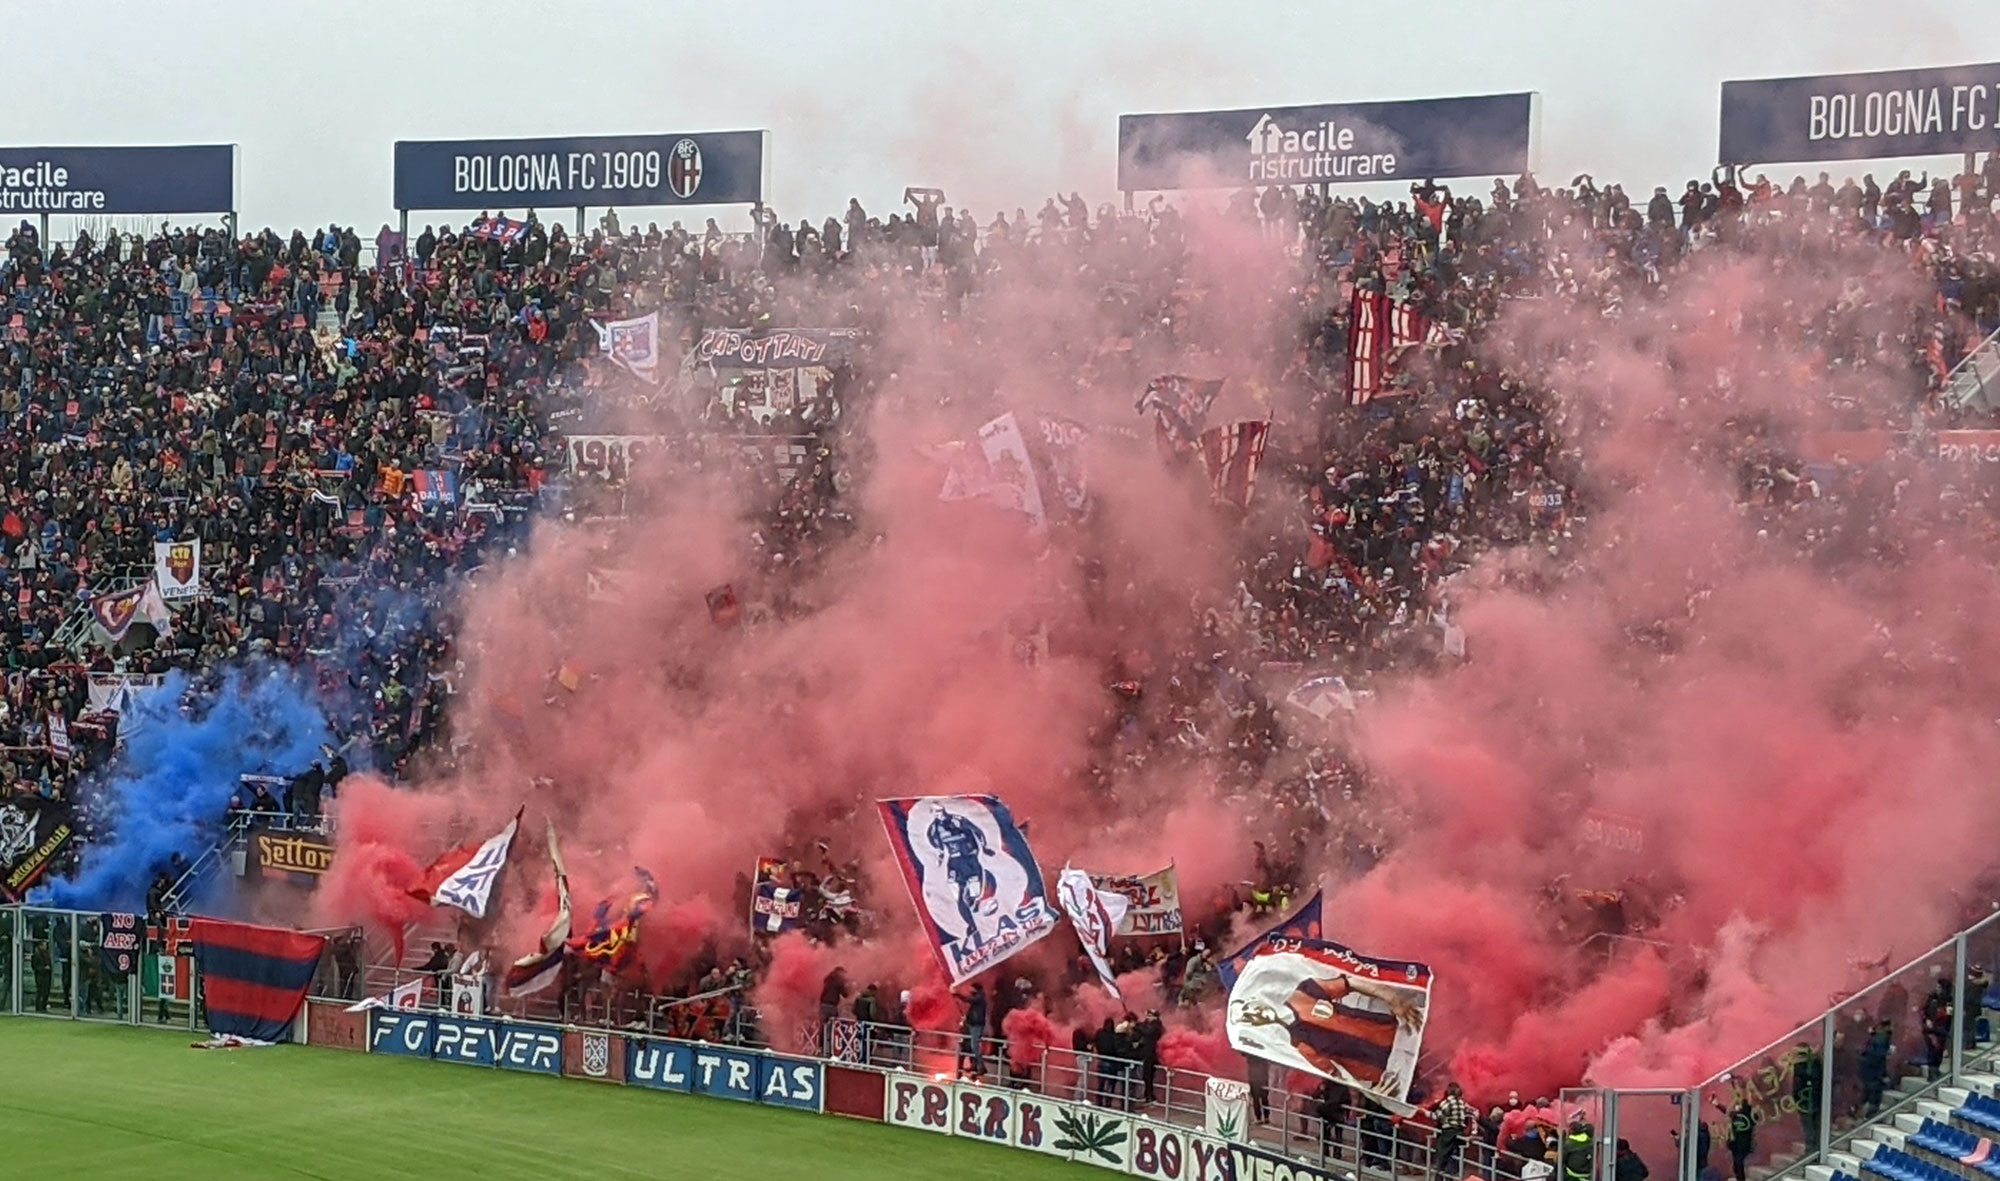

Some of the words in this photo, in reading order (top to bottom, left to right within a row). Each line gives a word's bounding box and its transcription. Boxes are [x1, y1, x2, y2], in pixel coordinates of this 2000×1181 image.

[1809, 87, 1942, 141] BOLOGNA
[1951, 84, 1987, 132] FC
[677, 141, 695, 154] BFC
[0, 161, 69, 188] acile
[454, 152, 562, 194] BOLOGNA
[568, 152, 596, 190] FC
[601, 149, 661, 190] 1909
[1249, 151, 1396, 180] ristrutturare
[701, 330, 826, 364] CAPOTTATI
[258, 835, 333, 869] Settor
[112, 913, 135, 929] NO
[950, 902, 1041, 963] KLAS
[117, 953, 131, 971] 9
[1322, 947, 1380, 977] Bologna
[372, 1016, 560, 1070] FOREVER
[634, 1049, 815, 1099] ULTRAS
[894, 1082, 1043, 1147] FREAK
